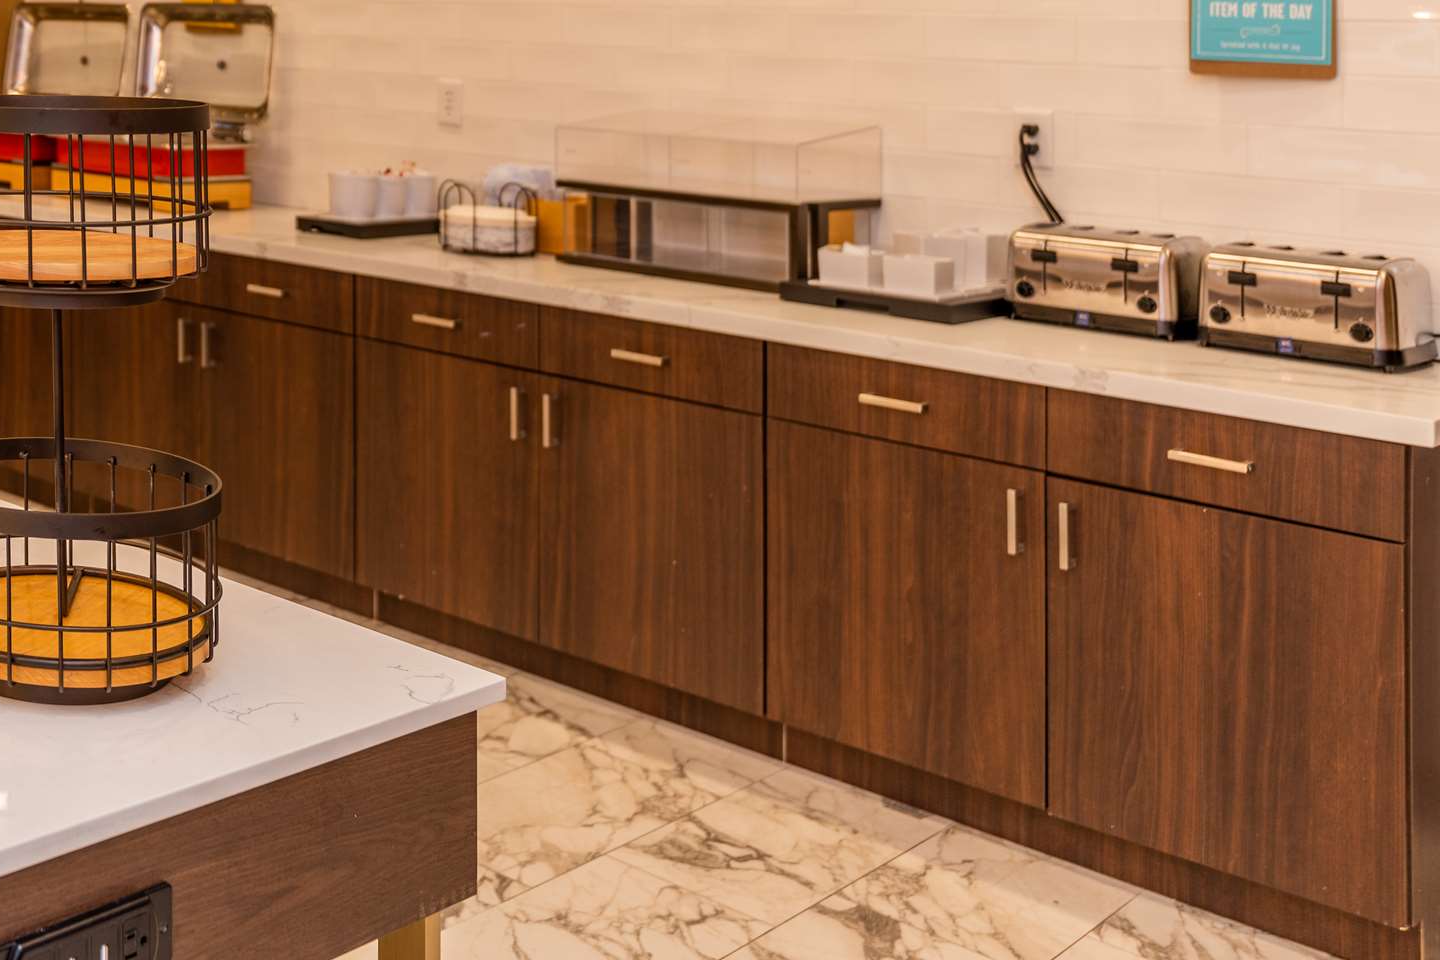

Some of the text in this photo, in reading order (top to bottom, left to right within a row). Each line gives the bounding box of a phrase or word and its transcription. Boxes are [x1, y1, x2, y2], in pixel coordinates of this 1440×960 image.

[1209, 1, 1313, 20] ITEM OF THE DAY
